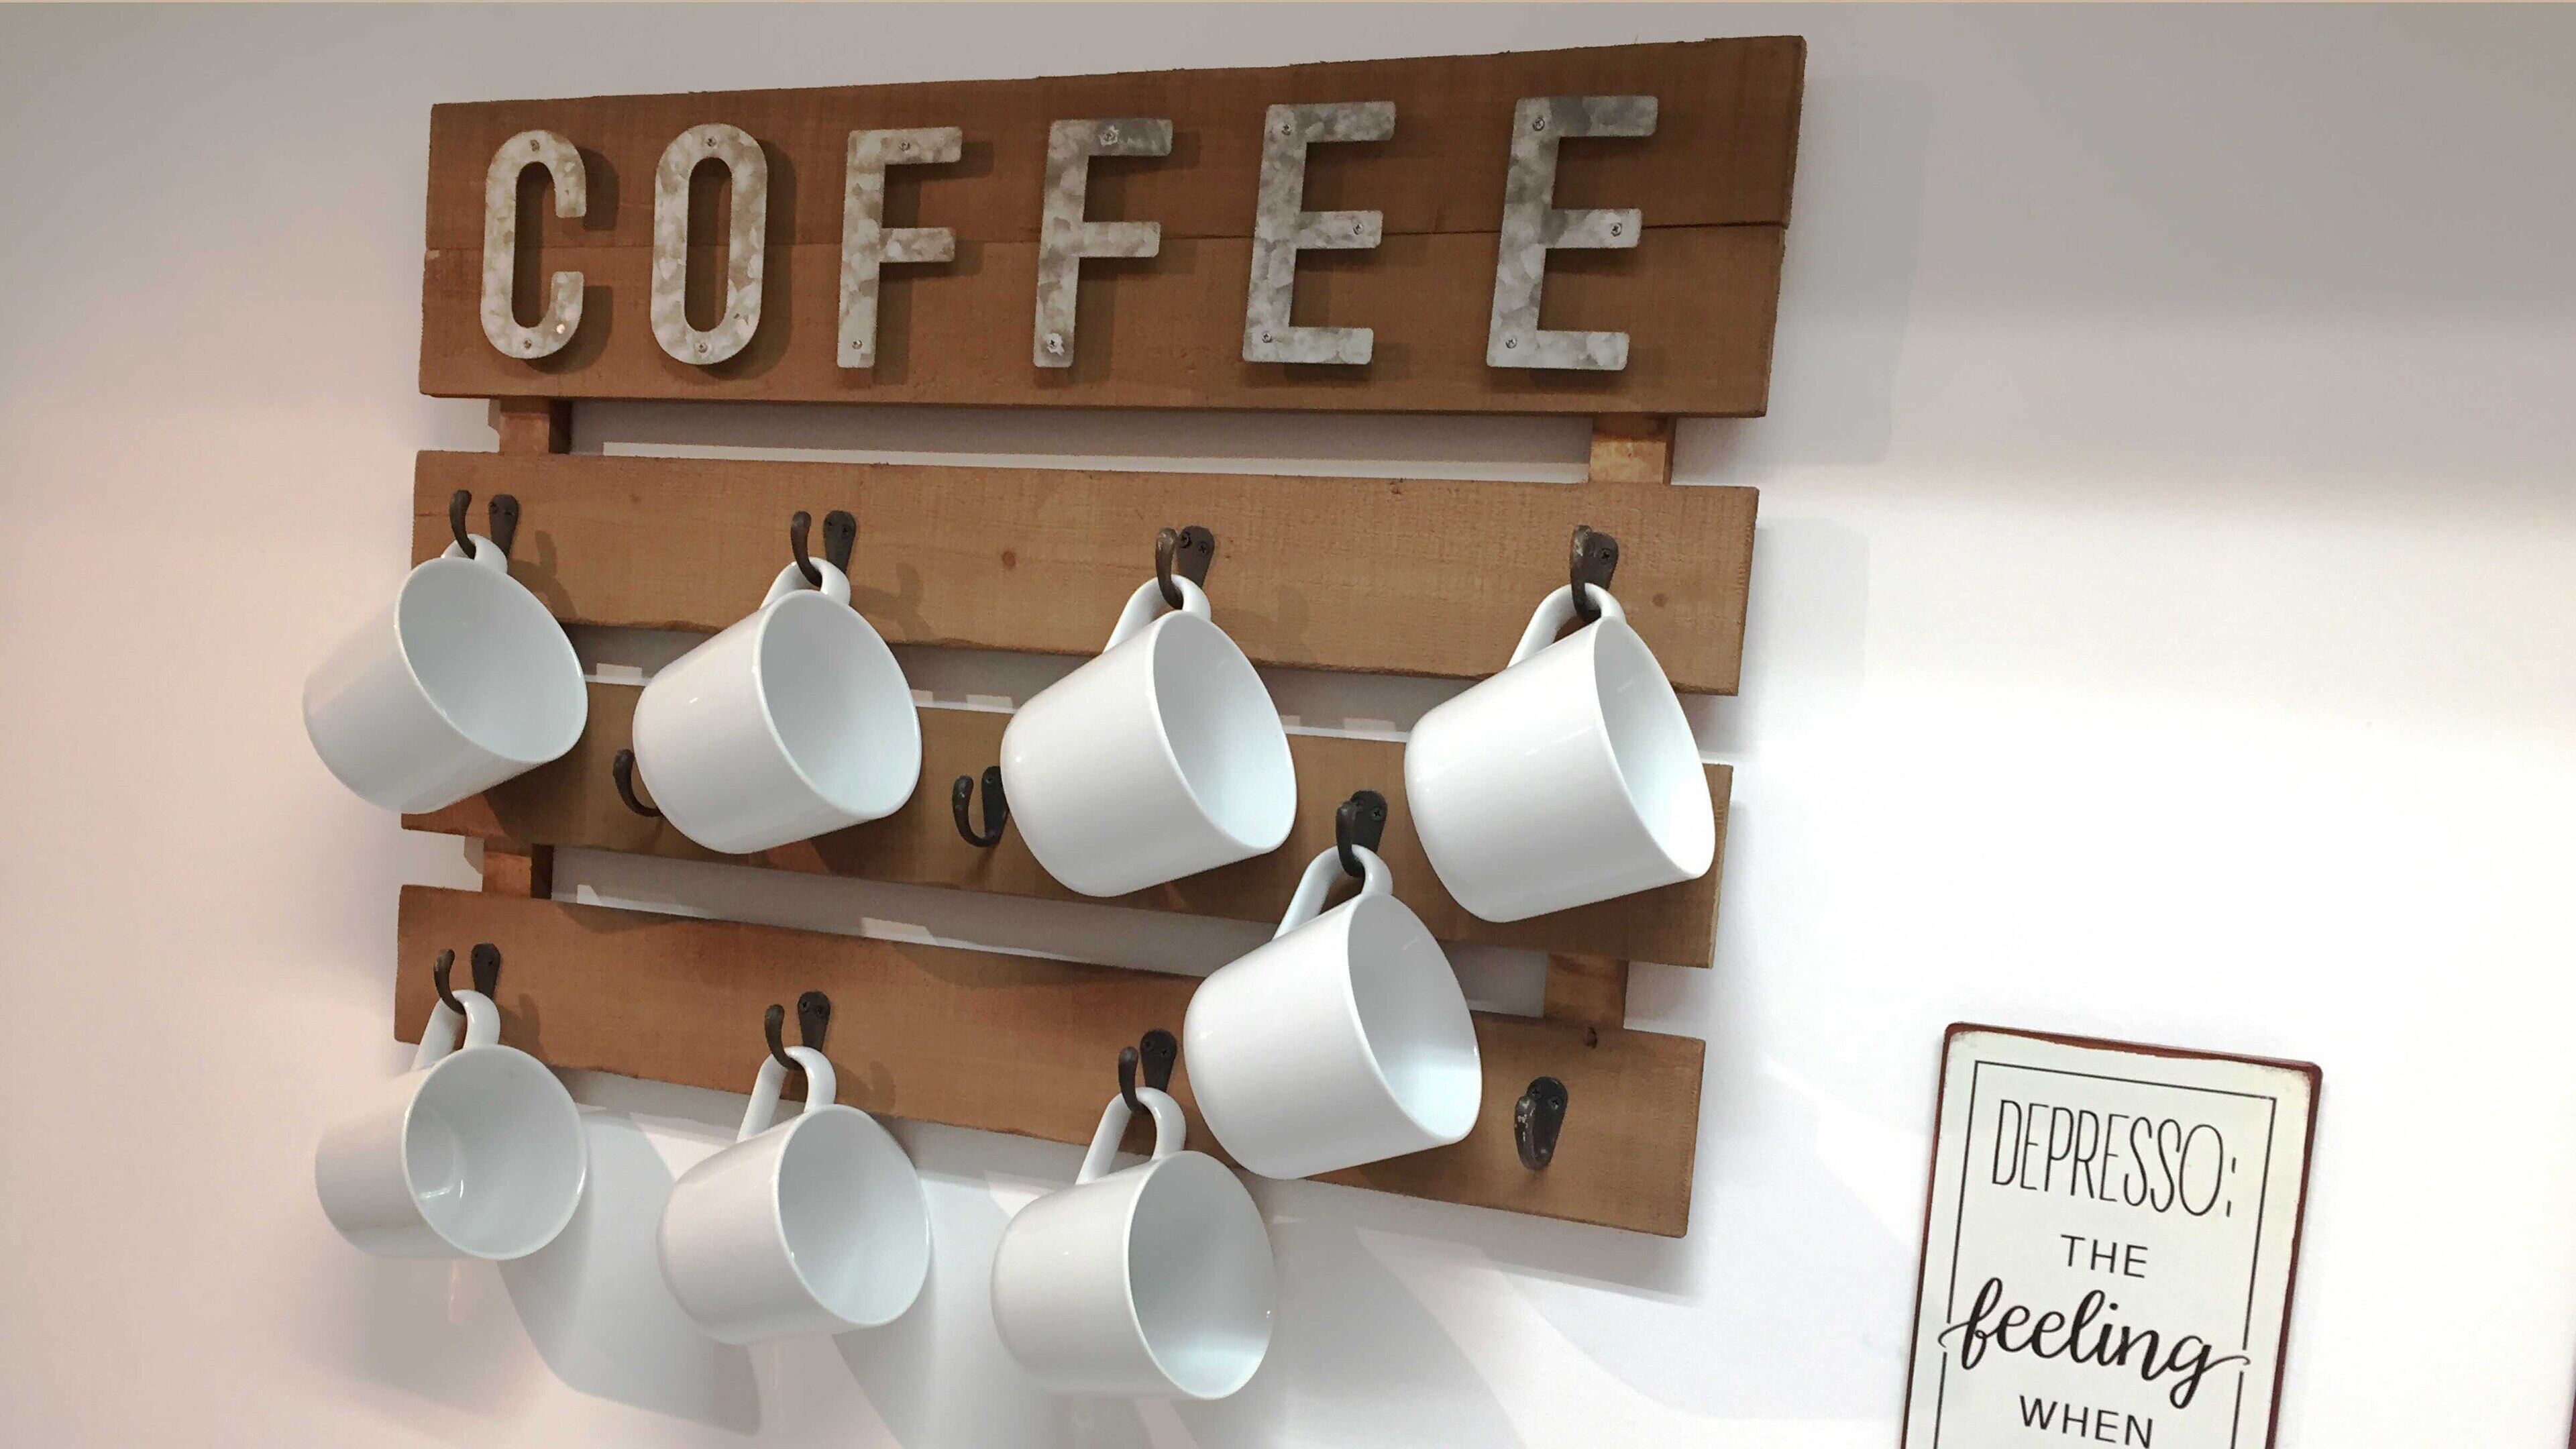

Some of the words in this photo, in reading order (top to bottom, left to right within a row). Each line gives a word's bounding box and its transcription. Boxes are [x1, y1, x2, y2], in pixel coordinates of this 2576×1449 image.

[479, 95, 1658, 371] COFFEE
[1992, 1099, 2237, 1218] DEPRESSO:
[2061, 1234, 2149, 1278] THE
[1938, 1277, 2250, 1409] feeling
[2019, 1395, 2153, 1449] WHEN
